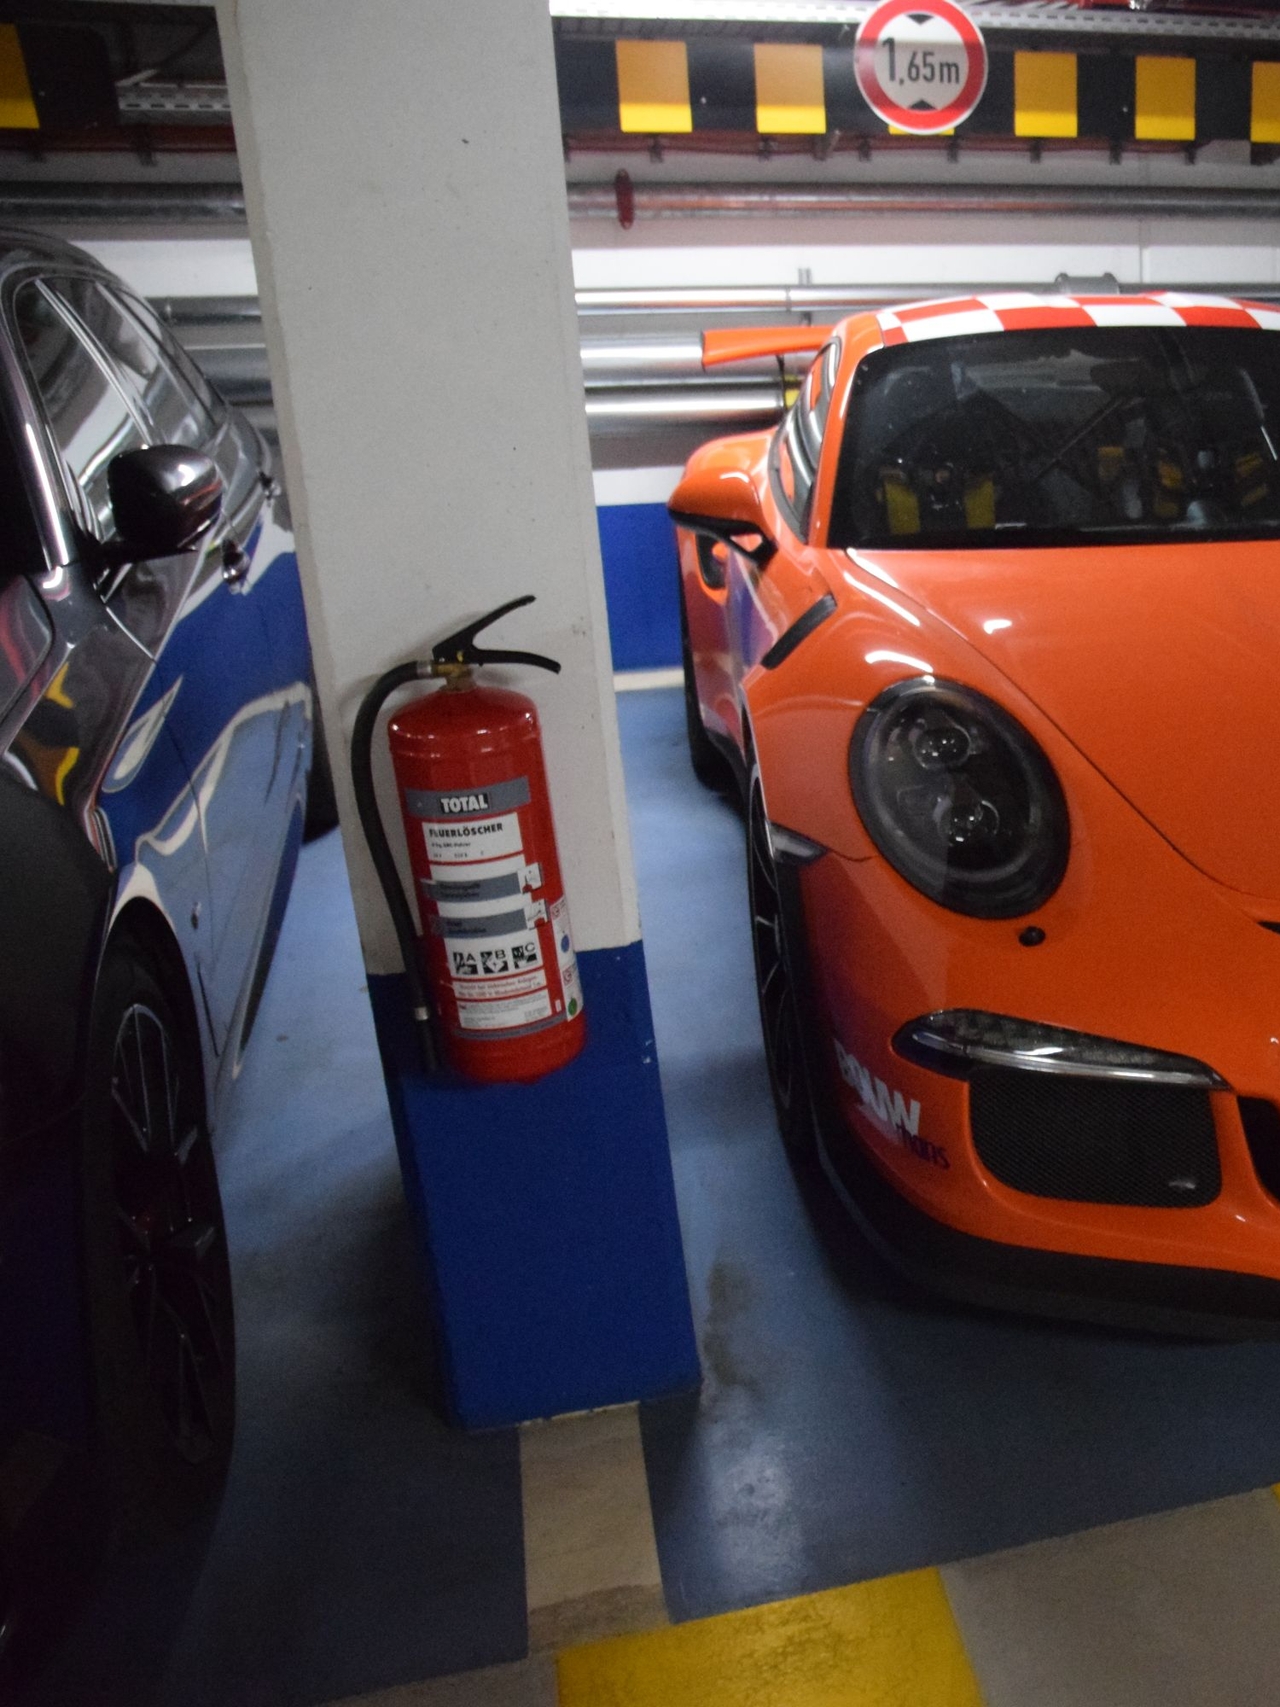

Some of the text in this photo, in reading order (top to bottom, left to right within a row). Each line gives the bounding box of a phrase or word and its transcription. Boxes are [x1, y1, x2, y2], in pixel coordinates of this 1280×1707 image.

[441, 794, 488, 813] TOTAL
[466, 942, 535, 963] A B C
